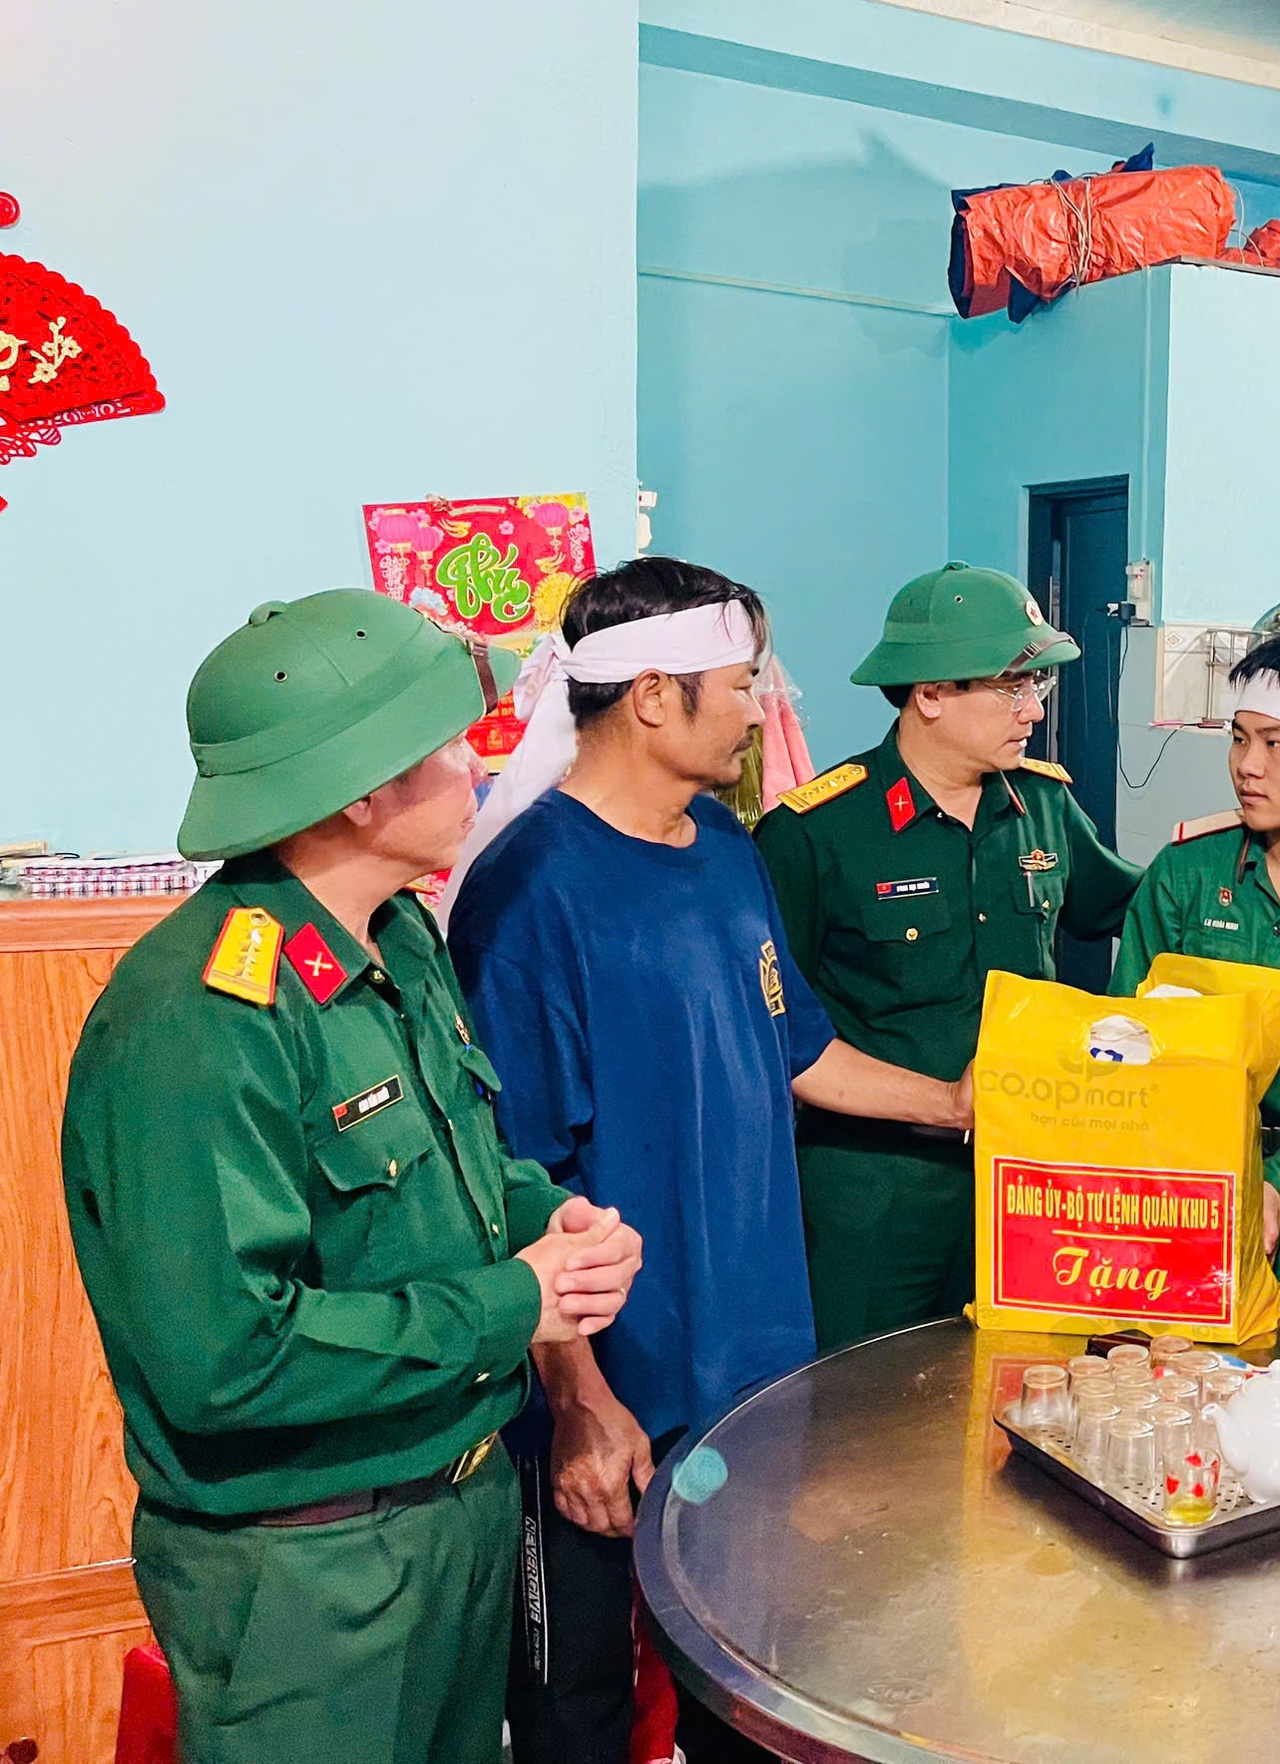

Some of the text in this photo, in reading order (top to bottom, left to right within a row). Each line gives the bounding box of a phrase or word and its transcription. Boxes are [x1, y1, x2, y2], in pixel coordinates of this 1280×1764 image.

[1007, 1174, 1042, 1217] ĐẢNG
[1087, 1190, 1105, 1223] TƯ
[1105, 1186, 1140, 1231] LỆNH
[1142, 1190, 1179, 1229] QUÂN
[1181, 1197, 1208, 1230] KHU
[1210, 1199, 1219, 1230] 5
[1052, 1246, 1171, 1300] Tặng
